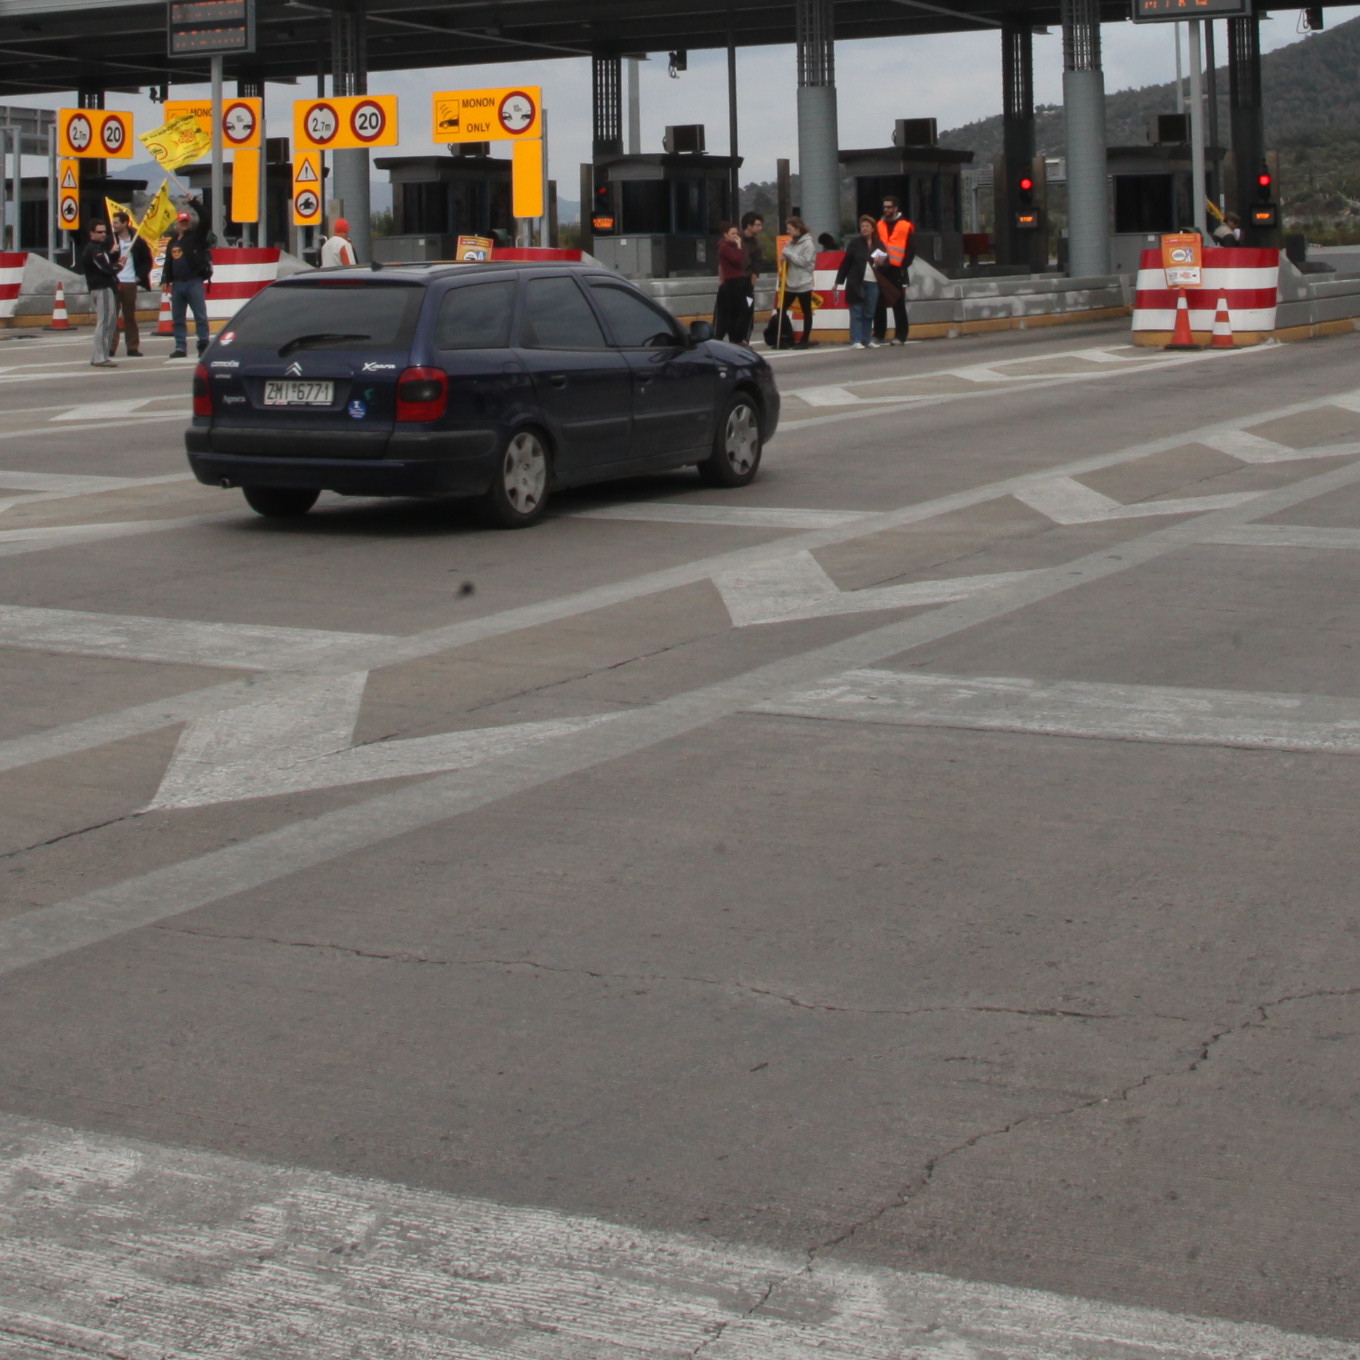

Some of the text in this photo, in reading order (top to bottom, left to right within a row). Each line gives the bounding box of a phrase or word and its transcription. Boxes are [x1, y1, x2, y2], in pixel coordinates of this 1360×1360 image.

[312, 117, 331, 132] 2.7m
[358, 112, 378, 130] 20
[466, 122, 490, 133] ONLY
[106, 126, 121, 142] 20
[267, 383, 328, 400] ZMI 6771
